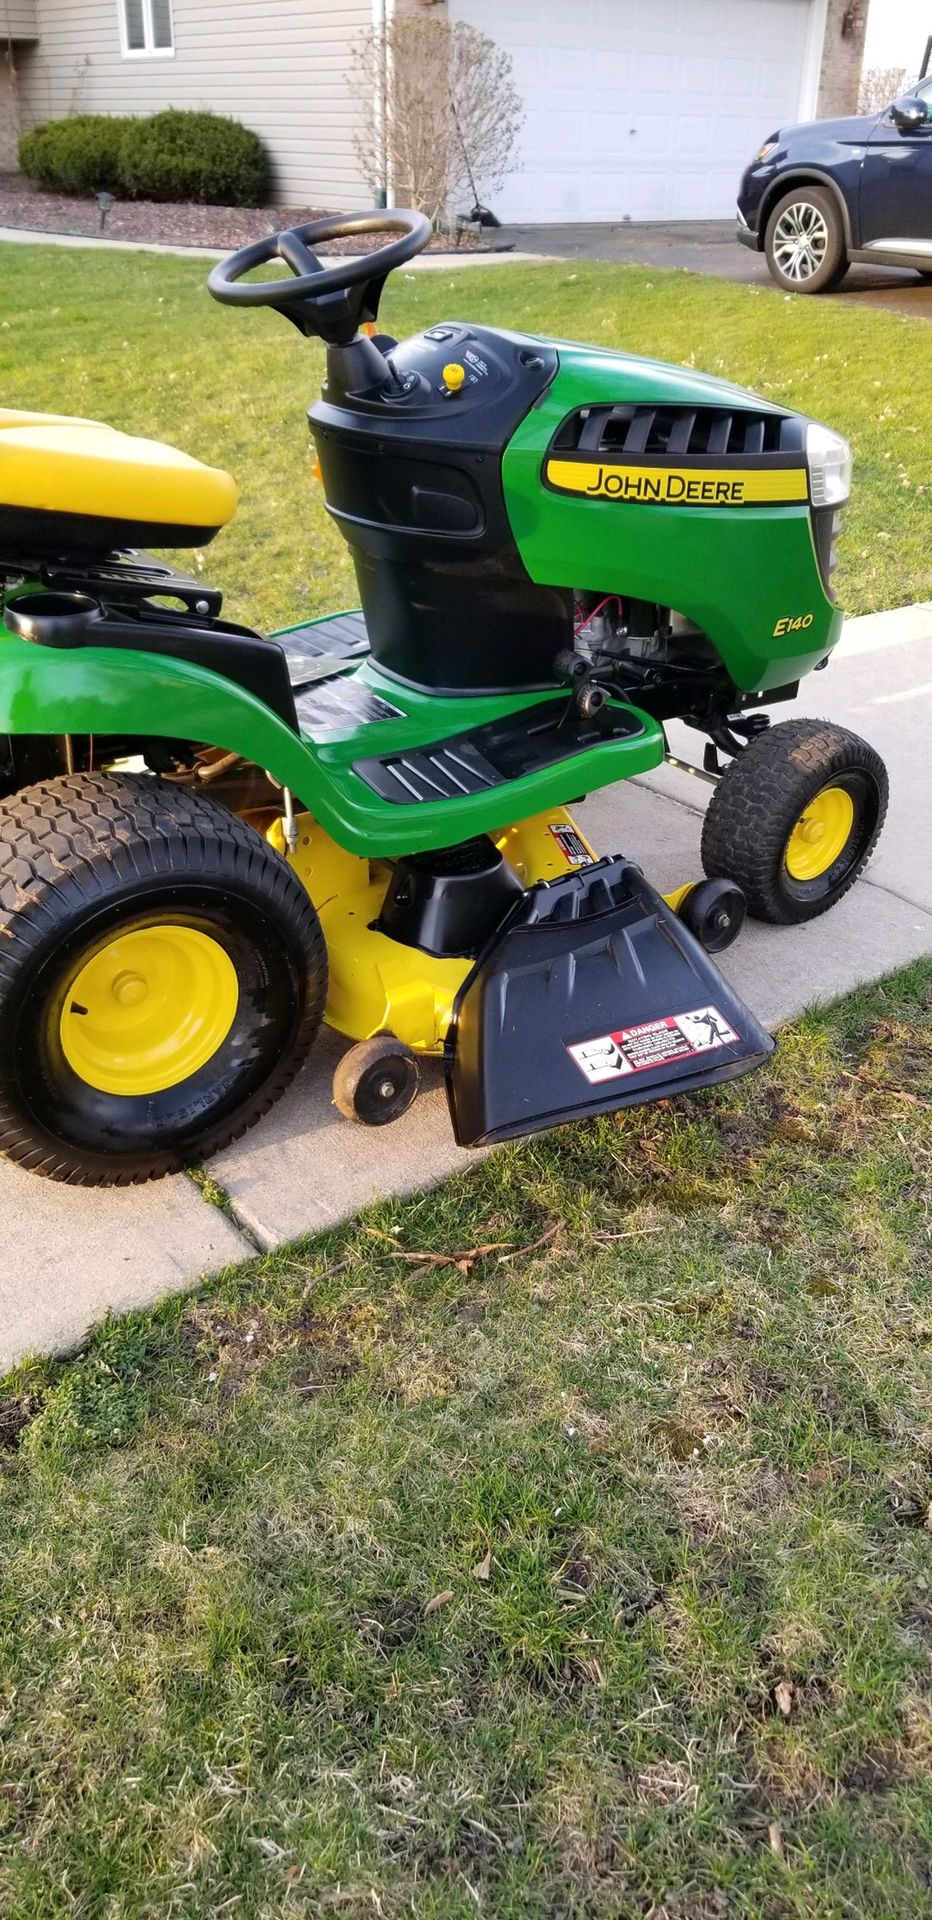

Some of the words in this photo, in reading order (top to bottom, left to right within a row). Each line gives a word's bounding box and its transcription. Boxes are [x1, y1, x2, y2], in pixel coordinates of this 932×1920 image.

[587, 468, 661, 498] JOHN
[666, 474, 745, 500] DEERE
[772, 613, 814, 638] E140
[629, 1021, 668, 1037] DANGER
